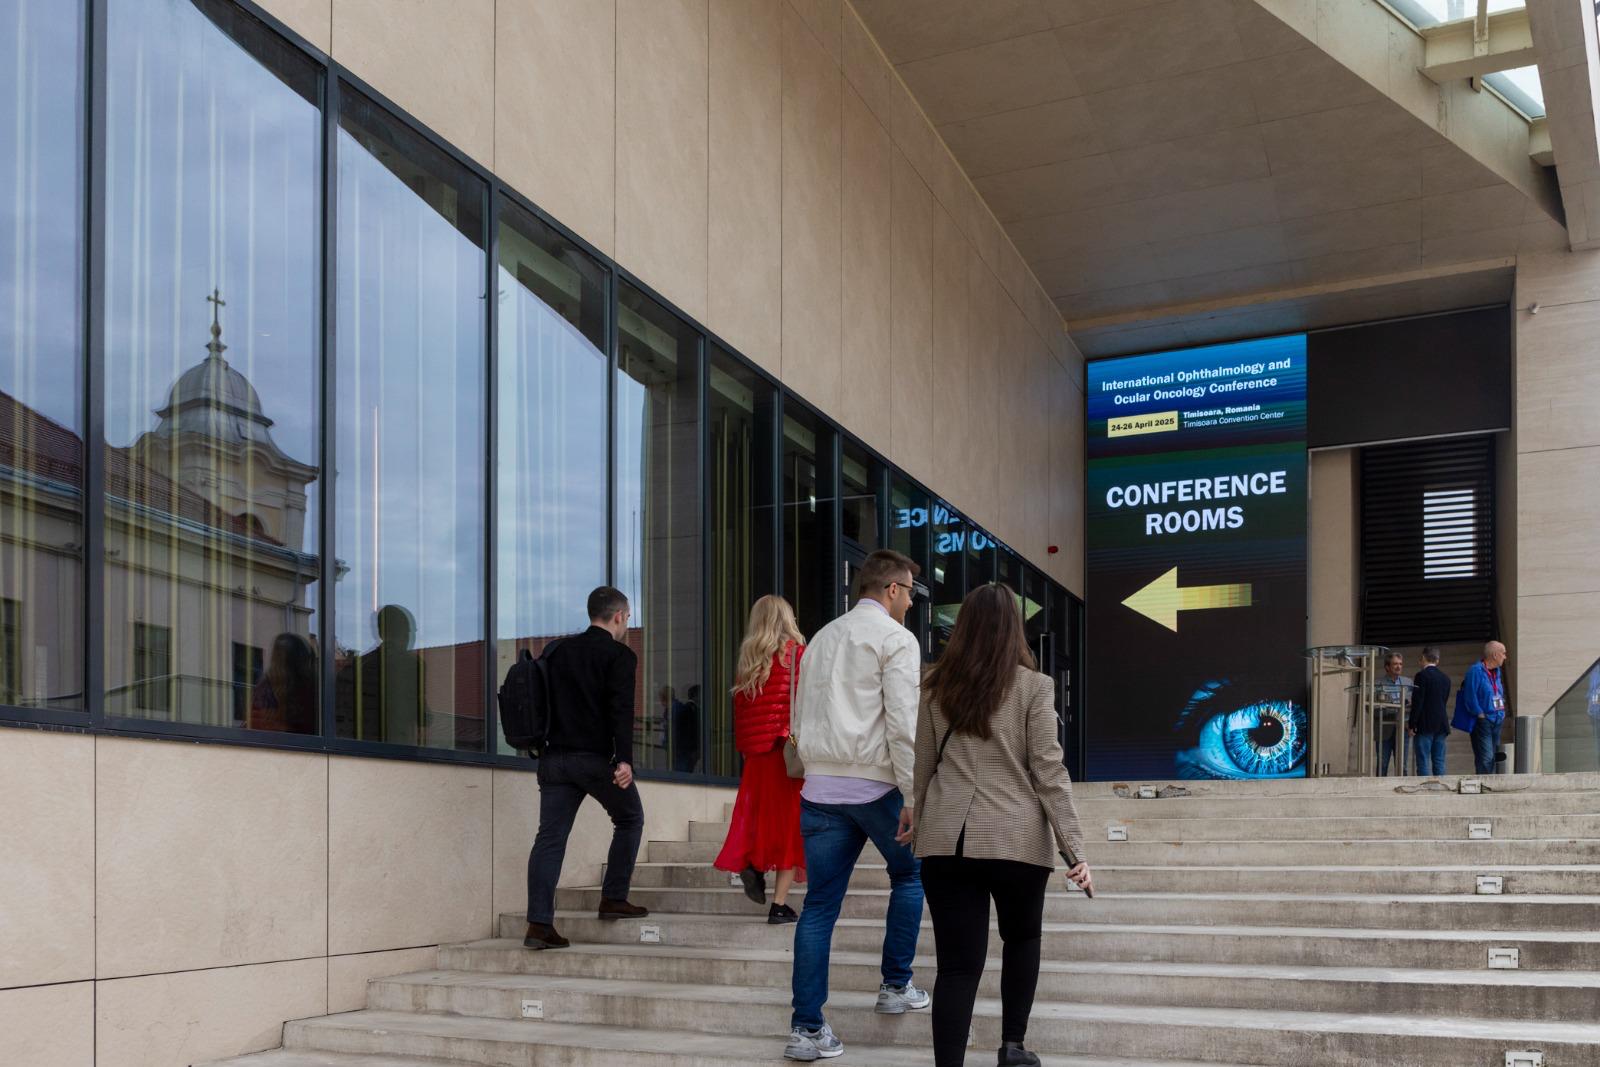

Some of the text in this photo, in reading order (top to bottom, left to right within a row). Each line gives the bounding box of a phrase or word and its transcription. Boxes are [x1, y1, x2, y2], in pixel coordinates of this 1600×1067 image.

[1102, 357, 1291, 391] International Ophthalmology and
[1114, 377, 1277, 405] Ocular Oncology Conference
[1183, 410, 1284, 428] Timisoara Convention Center
[1225, 403, 1261, 414] Romania
[1111, 417, 1175, 432] 24-26 April 2025
[1106, 470, 1287, 508] CONFERENCE
[1145, 506, 1244, 535] ROOMS
